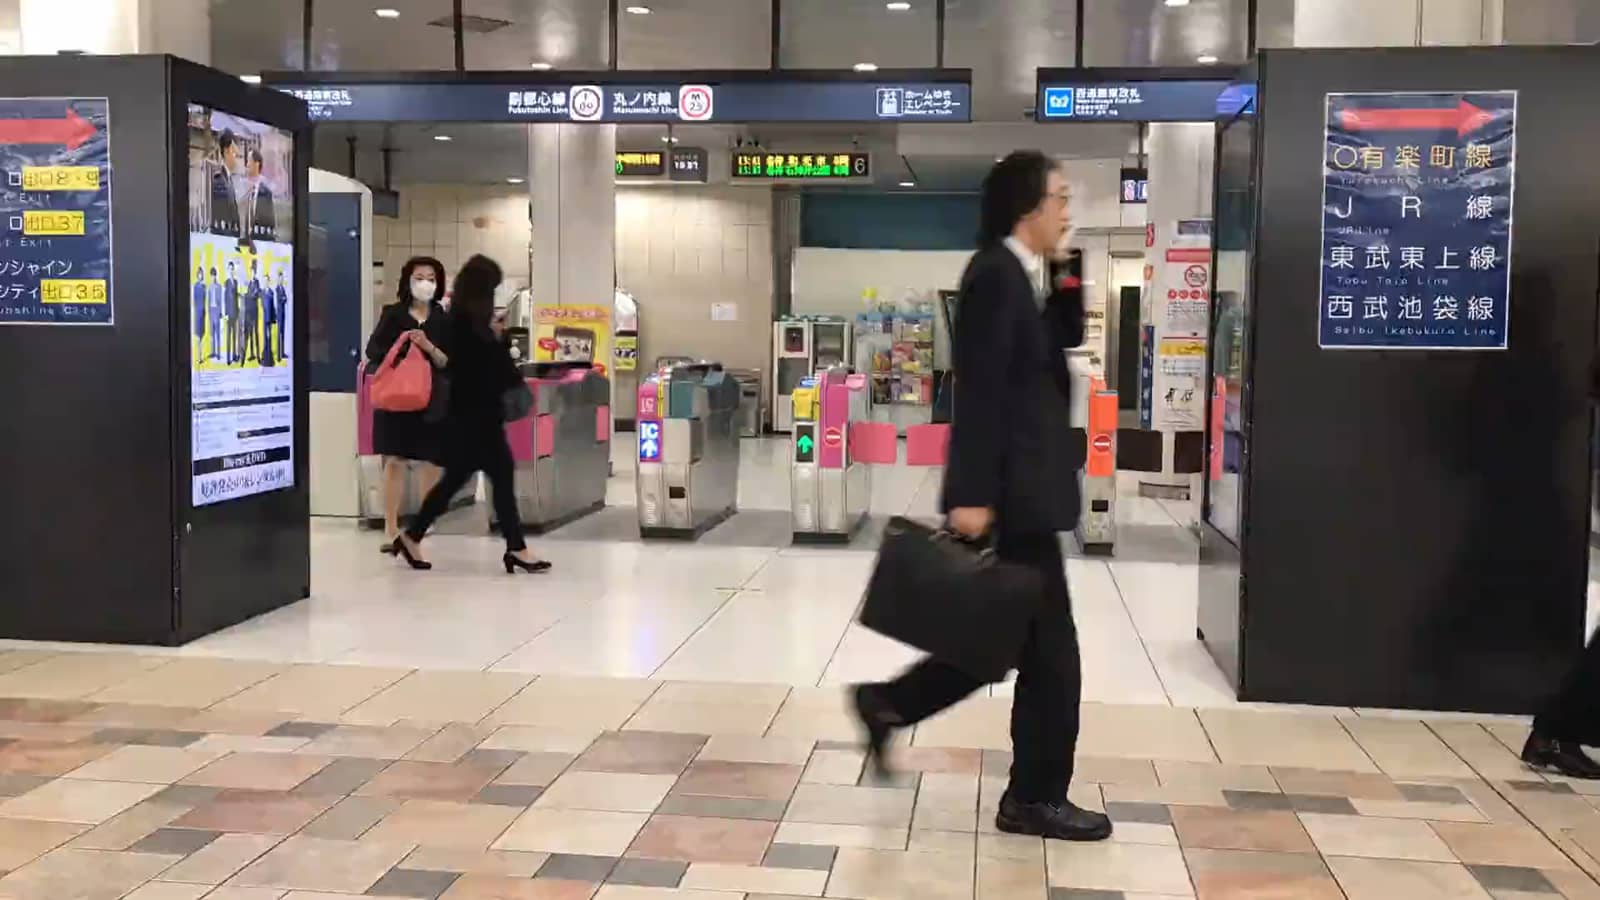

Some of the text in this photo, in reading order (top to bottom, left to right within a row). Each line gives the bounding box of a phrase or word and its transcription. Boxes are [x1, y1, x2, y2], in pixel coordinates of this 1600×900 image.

[509, 91, 566, 106] 副都心線
[613, 91, 672, 106] 丸ノ内線
[905, 90, 952, 99] ホームゆき
[905, 99, 961, 109] エレベーター
[855, 158, 865, 174] 6
[1330, 245, 1496, 271] 東武東上線
[1417, 276, 1449, 286] Line
[1328, 295, 1494, 320] 西武池袋線
[1335, 326, 1497, 336] Seibu Ikebukuro Line
[641, 423, 659, 440] IC
